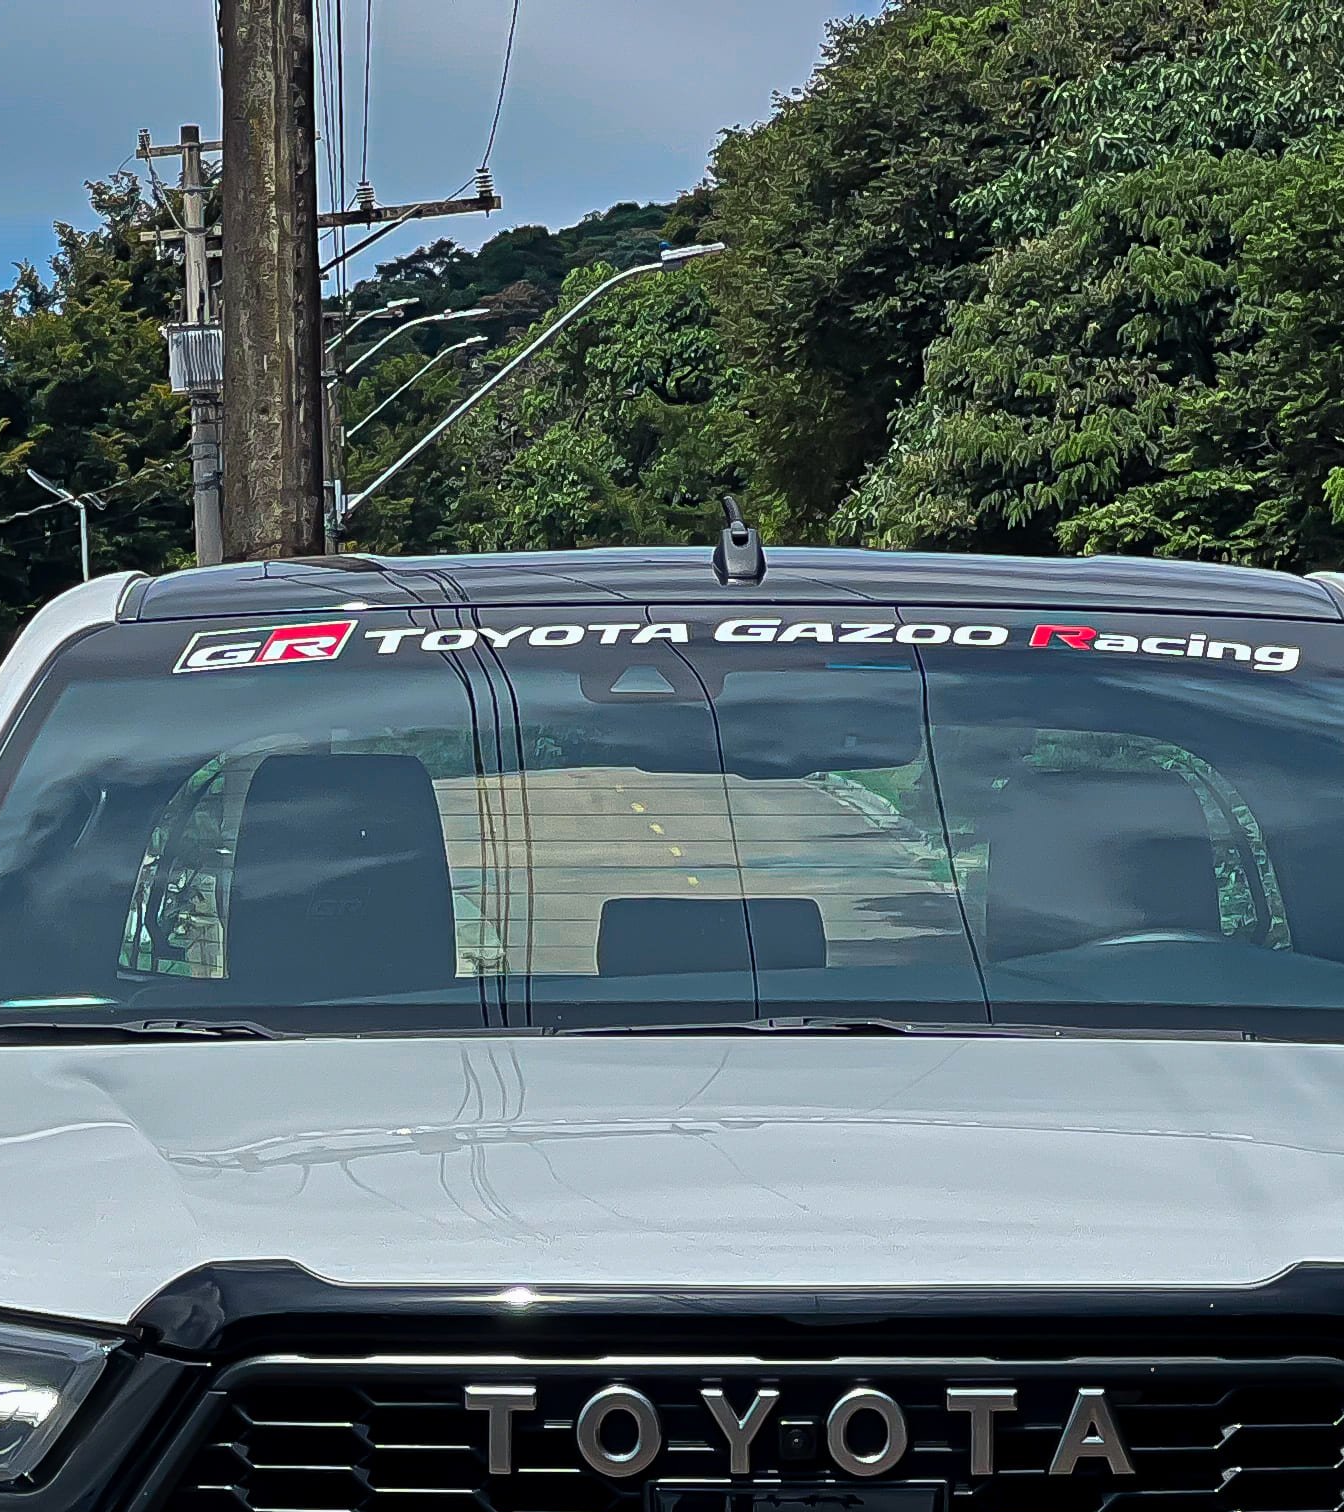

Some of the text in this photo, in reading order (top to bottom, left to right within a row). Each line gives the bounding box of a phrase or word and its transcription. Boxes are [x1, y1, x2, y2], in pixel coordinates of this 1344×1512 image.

[187, 635, 338, 668] GR
[364, 624, 689, 655] TOYOTA
[1028, 624, 1301, 672] Racing
[464, 1384, 1136, 1478] TOYOTA
